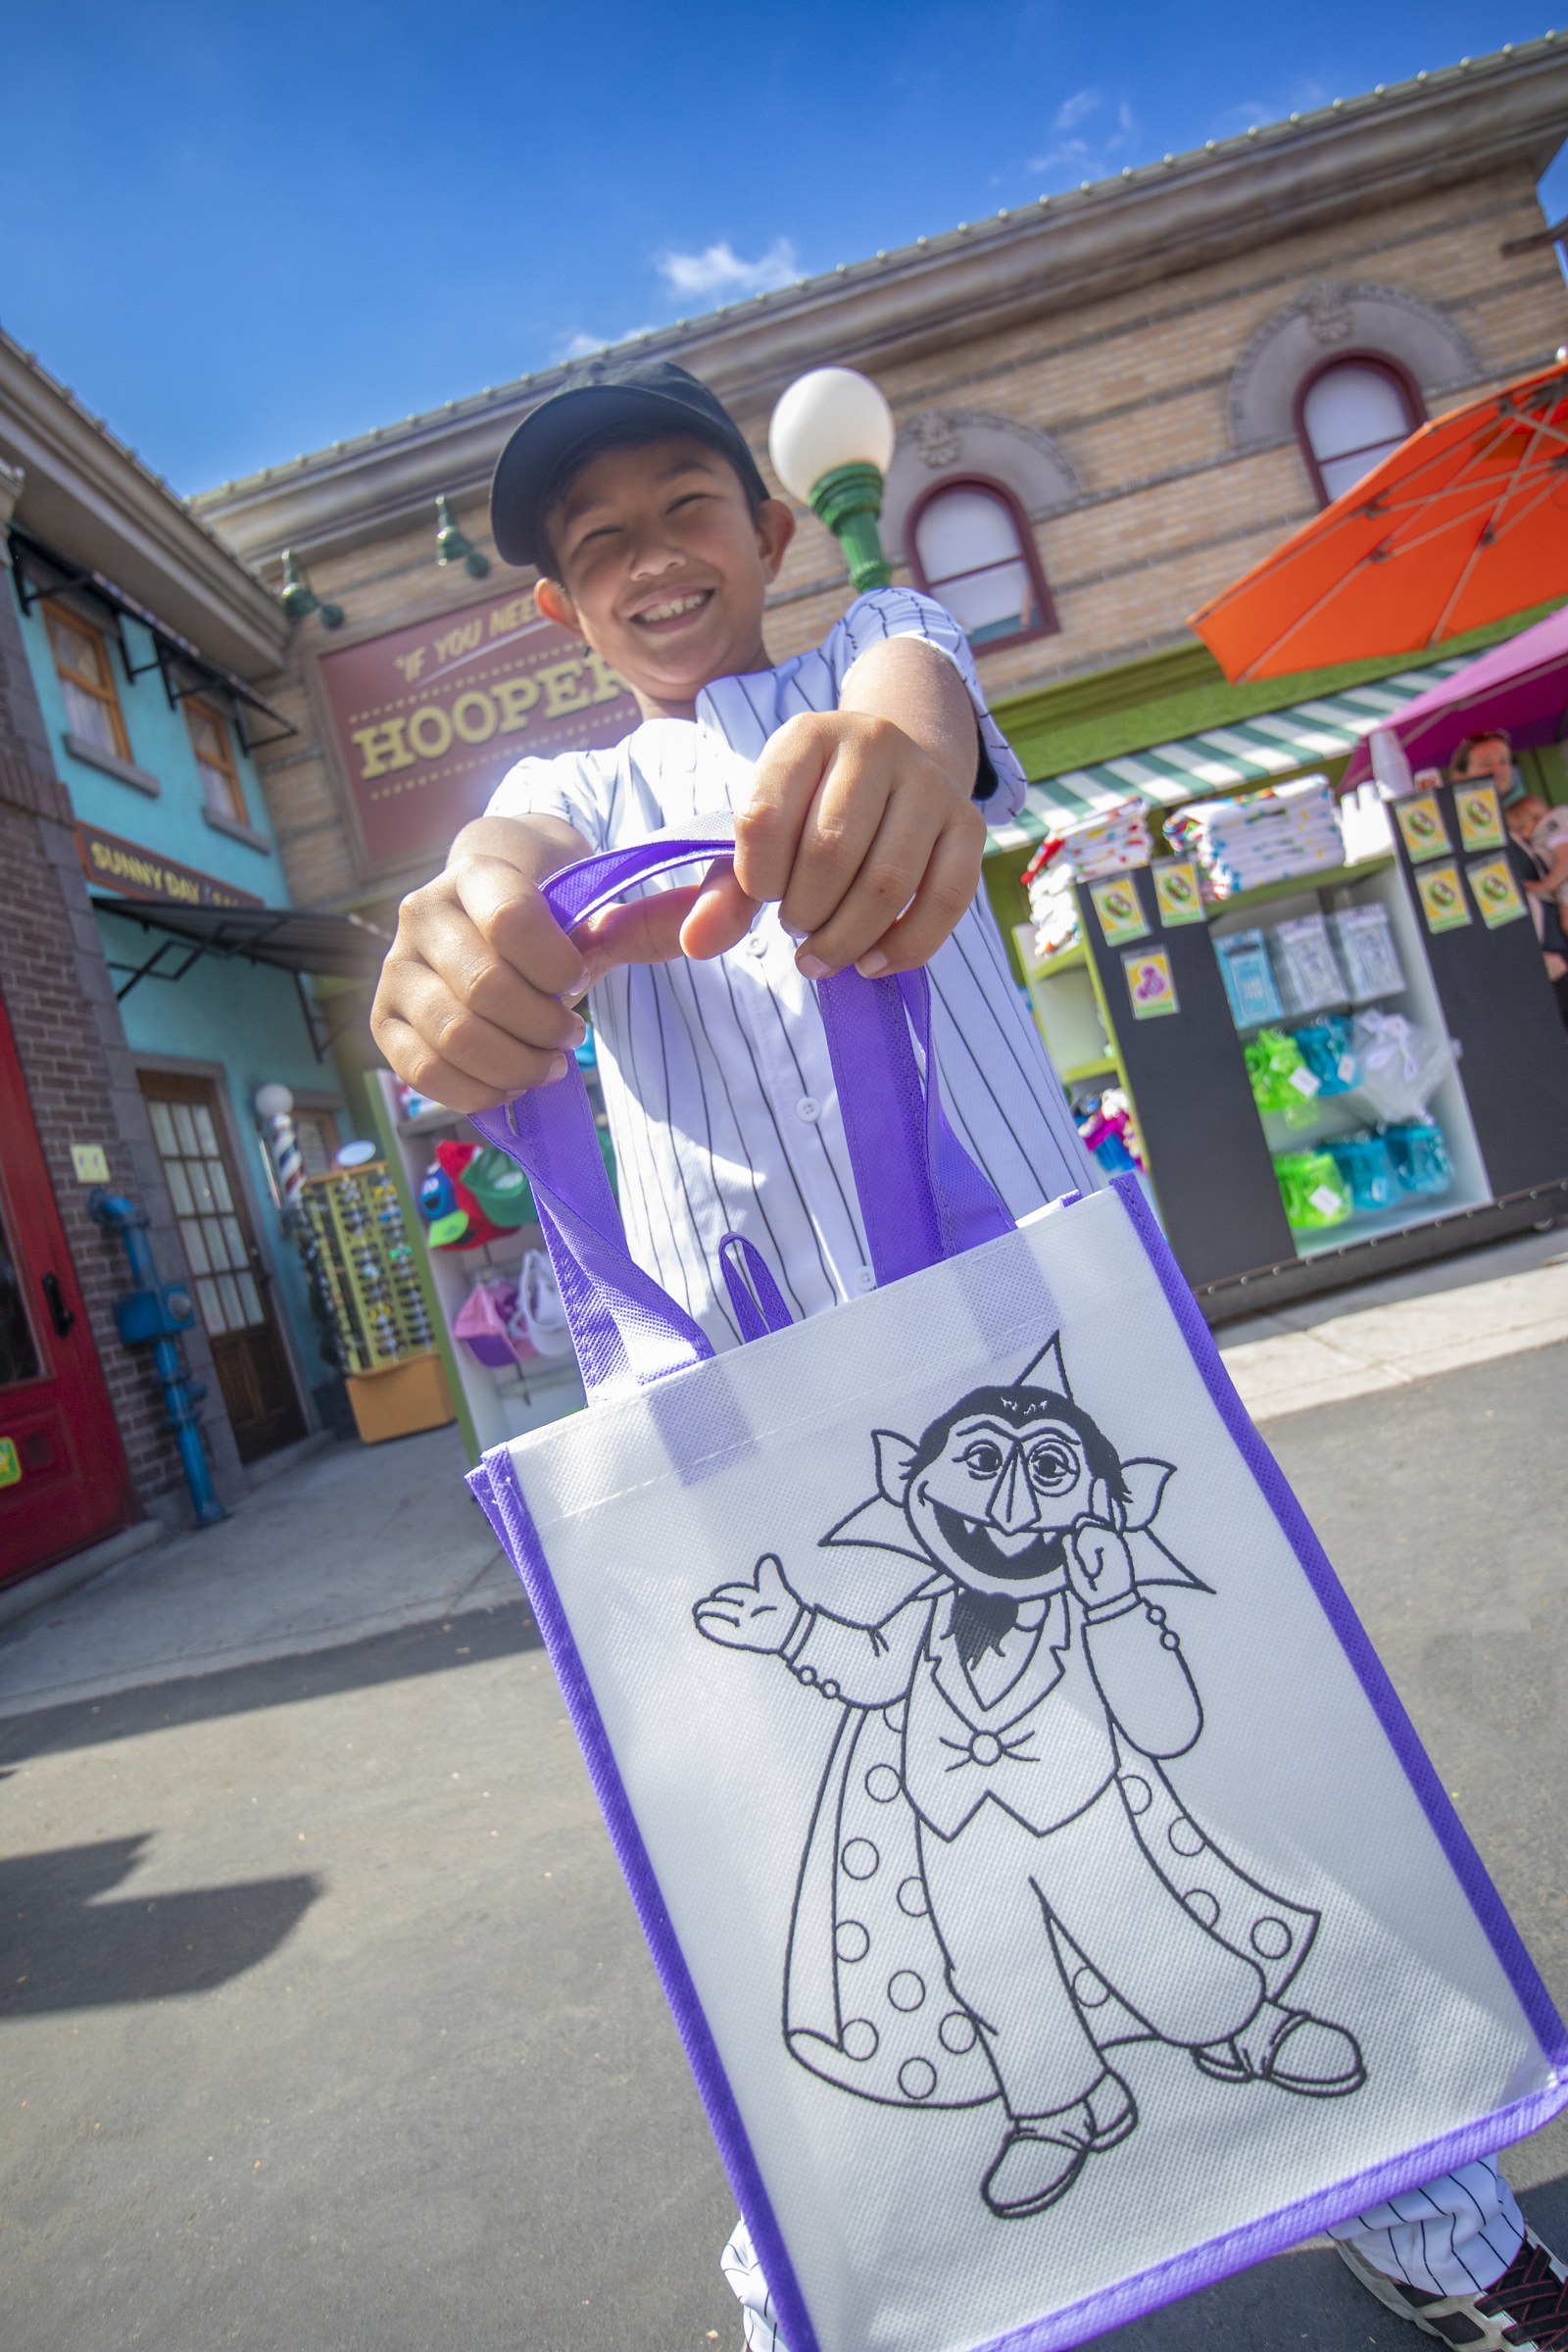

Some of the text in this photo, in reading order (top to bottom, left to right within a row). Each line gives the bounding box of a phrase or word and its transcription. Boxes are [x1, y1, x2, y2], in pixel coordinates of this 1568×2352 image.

[433, 616, 483, 663] YOU
[90, 840, 163, 891] SUNNY
[164, 870, 200, 906] DAY
